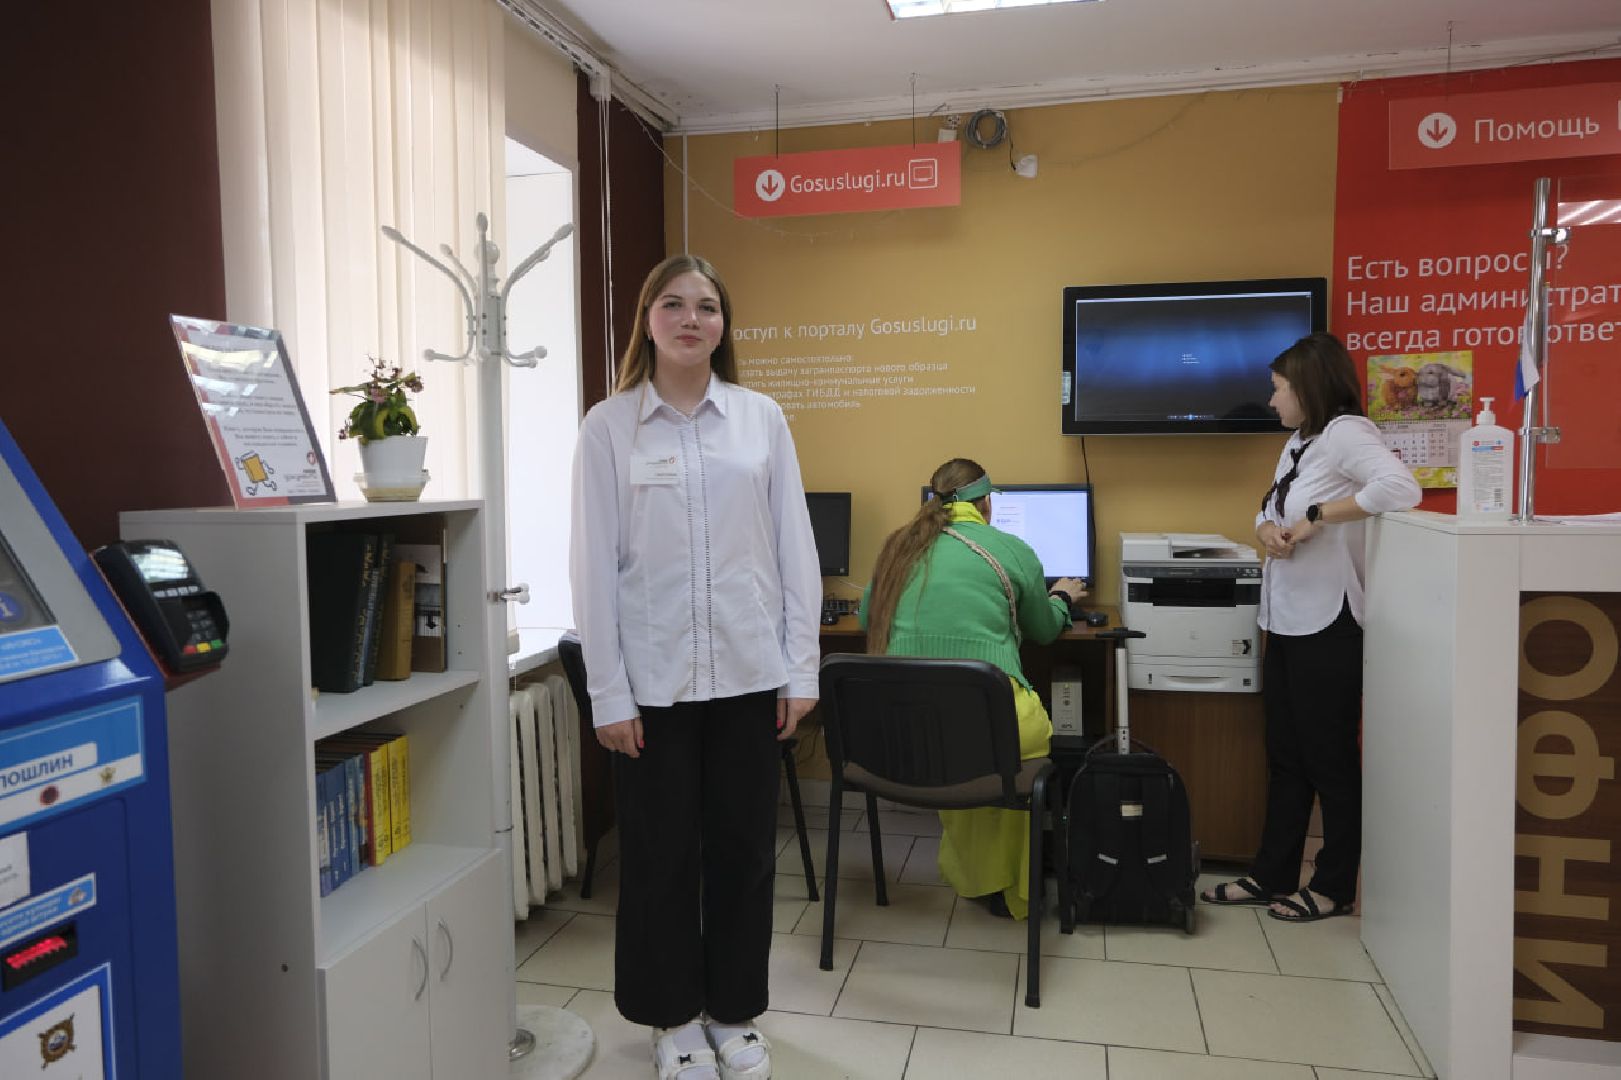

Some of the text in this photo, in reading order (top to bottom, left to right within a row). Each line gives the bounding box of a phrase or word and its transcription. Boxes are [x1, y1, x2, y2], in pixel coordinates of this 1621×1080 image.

[1474, 116, 1600, 144] Помощь
[790, 169, 905, 194] Gosuslugi.ru
[1347, 255, 1409, 281] Есть
[1347, 283, 1621, 316] Наш админтрат
[733, 315, 977, 343] оступ к порталу Gosuslugi.ru
[1346, 328, 1440, 351] всегда
[1547, 321, 1621, 344] отве
[806, 387, 841, 398] ГИБДД
[1513, 595, 1618, 1029] ИНФО
